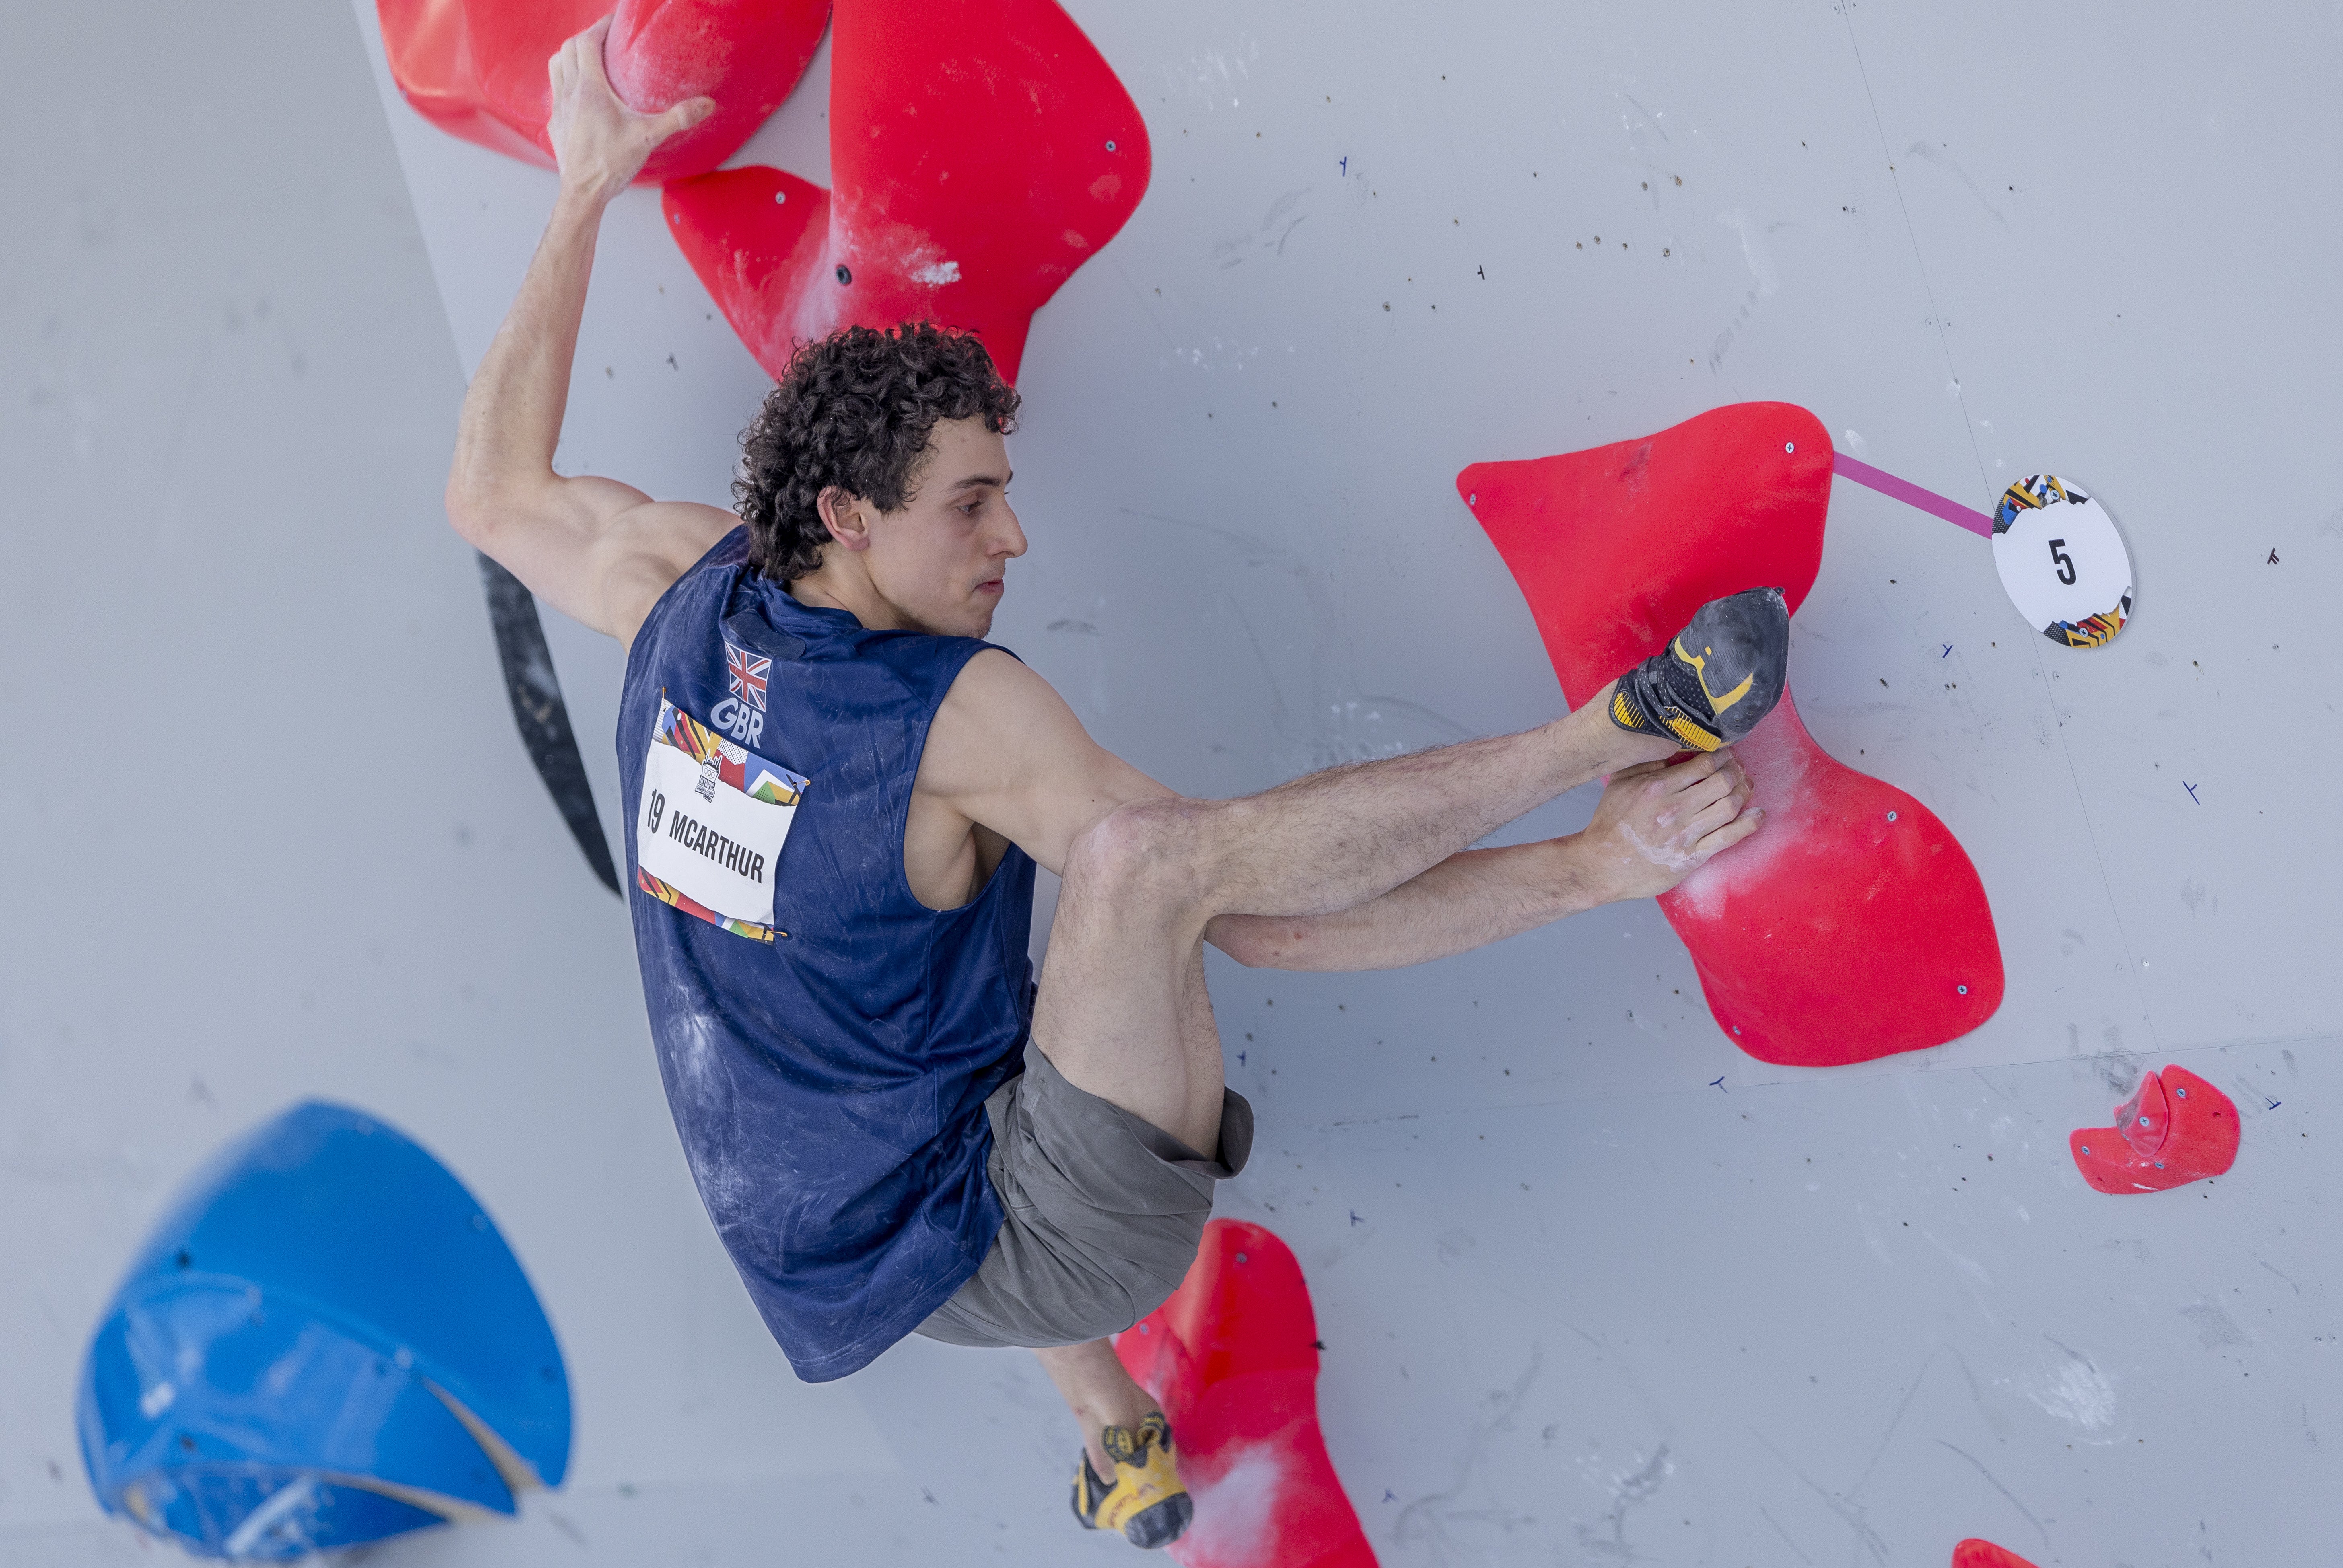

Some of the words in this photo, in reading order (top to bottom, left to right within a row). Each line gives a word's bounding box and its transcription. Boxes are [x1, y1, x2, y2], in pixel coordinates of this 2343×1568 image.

[2048, 538, 2077, 585] 5
[710, 697, 764, 749] GBR
[1674, 726, 1688, 738] COMP
[699, 776, 714, 790] OLYMPIC
[647, 788, 665, 834] 19
[669, 810, 764, 884] MCARTHUR
